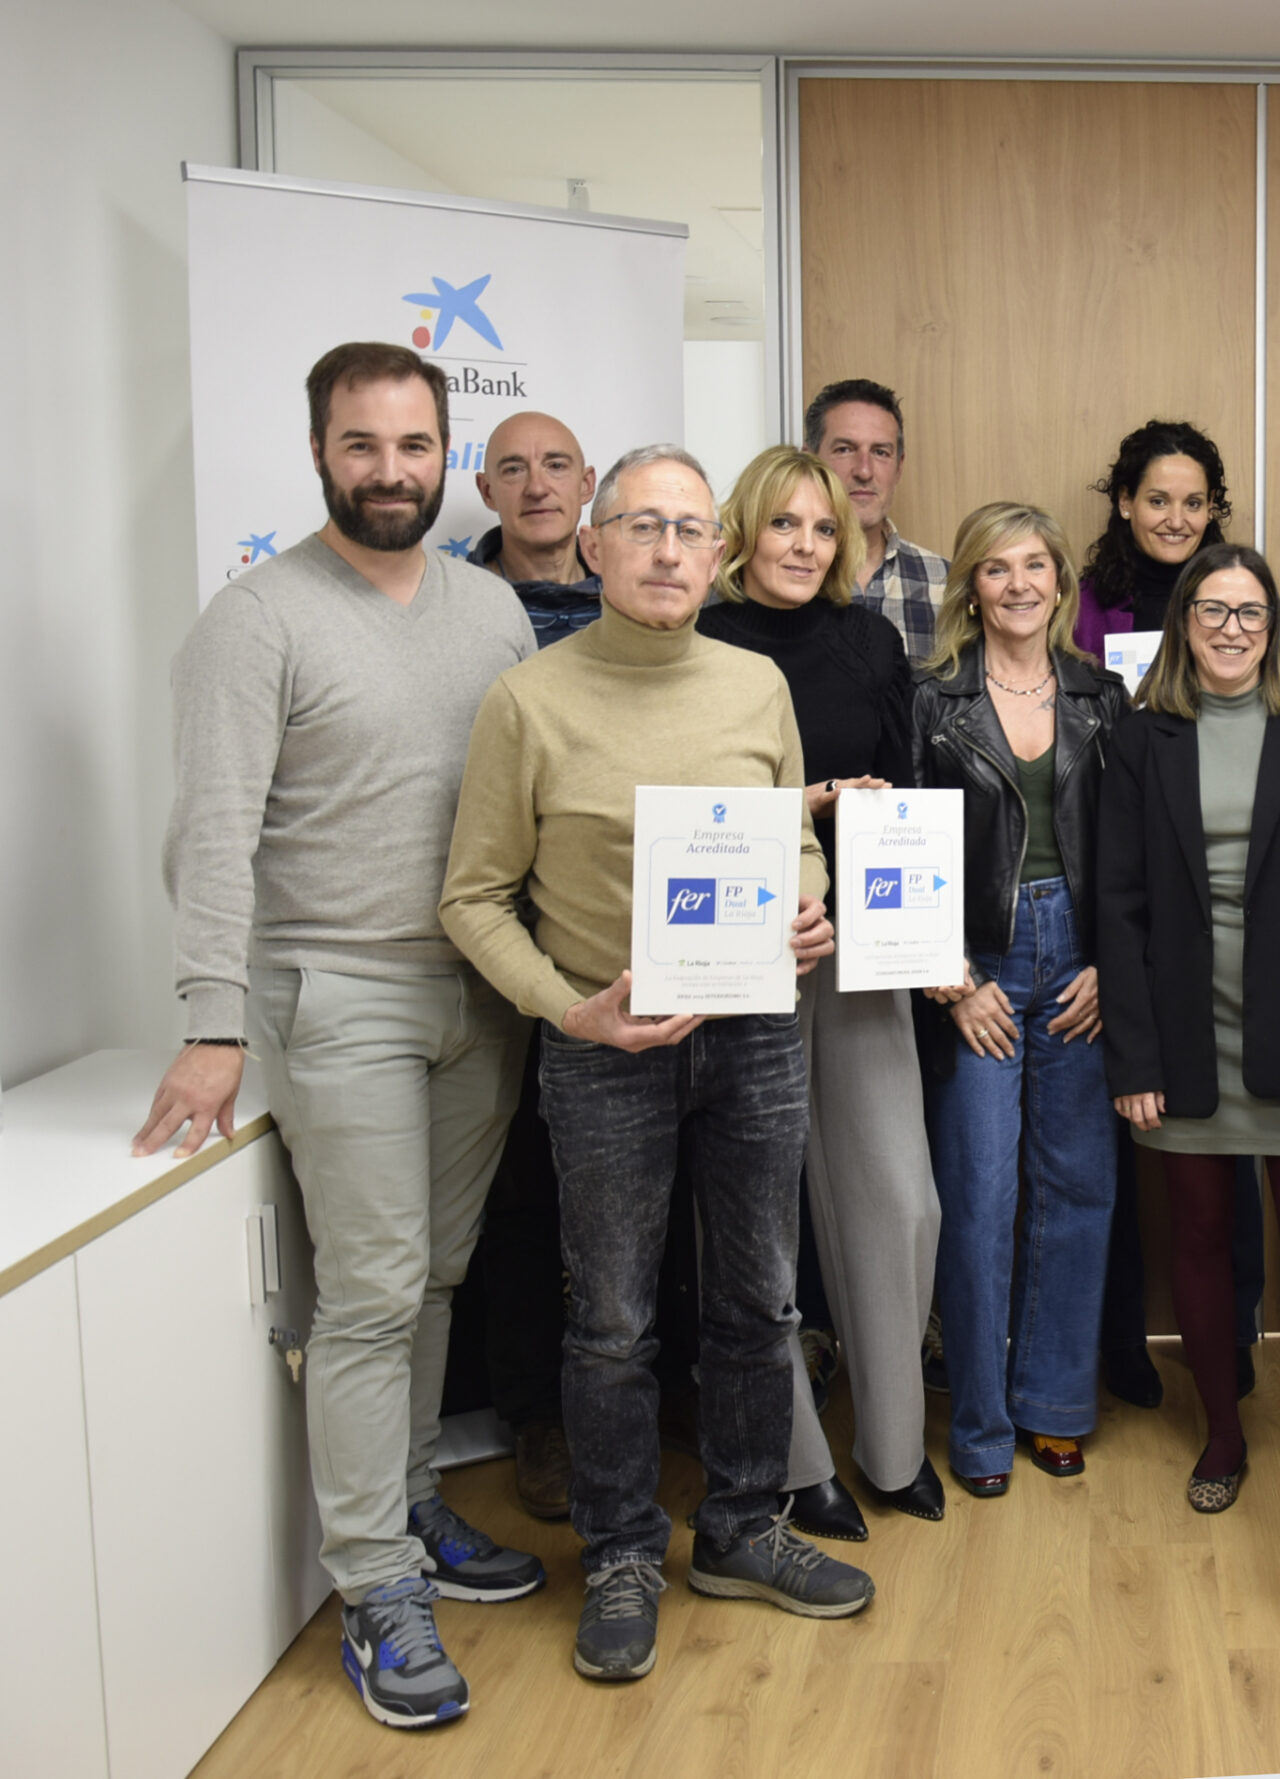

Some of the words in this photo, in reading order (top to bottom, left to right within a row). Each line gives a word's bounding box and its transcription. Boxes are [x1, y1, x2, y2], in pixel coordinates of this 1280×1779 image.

[446, 366, 528, 398] aBank
[446, 441, 486, 472] ali
[692, 828, 745, 843] Empresa
[882, 824, 923, 837] Empresa
[685, 842, 751, 855] Acreditada
[878, 836, 927, 848] Acreditada
[908, 873, 923, 885] FP
[724, 885, 744, 898] FP
[865, 876, 899, 910] fer
[666, 888, 712, 925] fer
[723, 899, 747, 908] Dual
